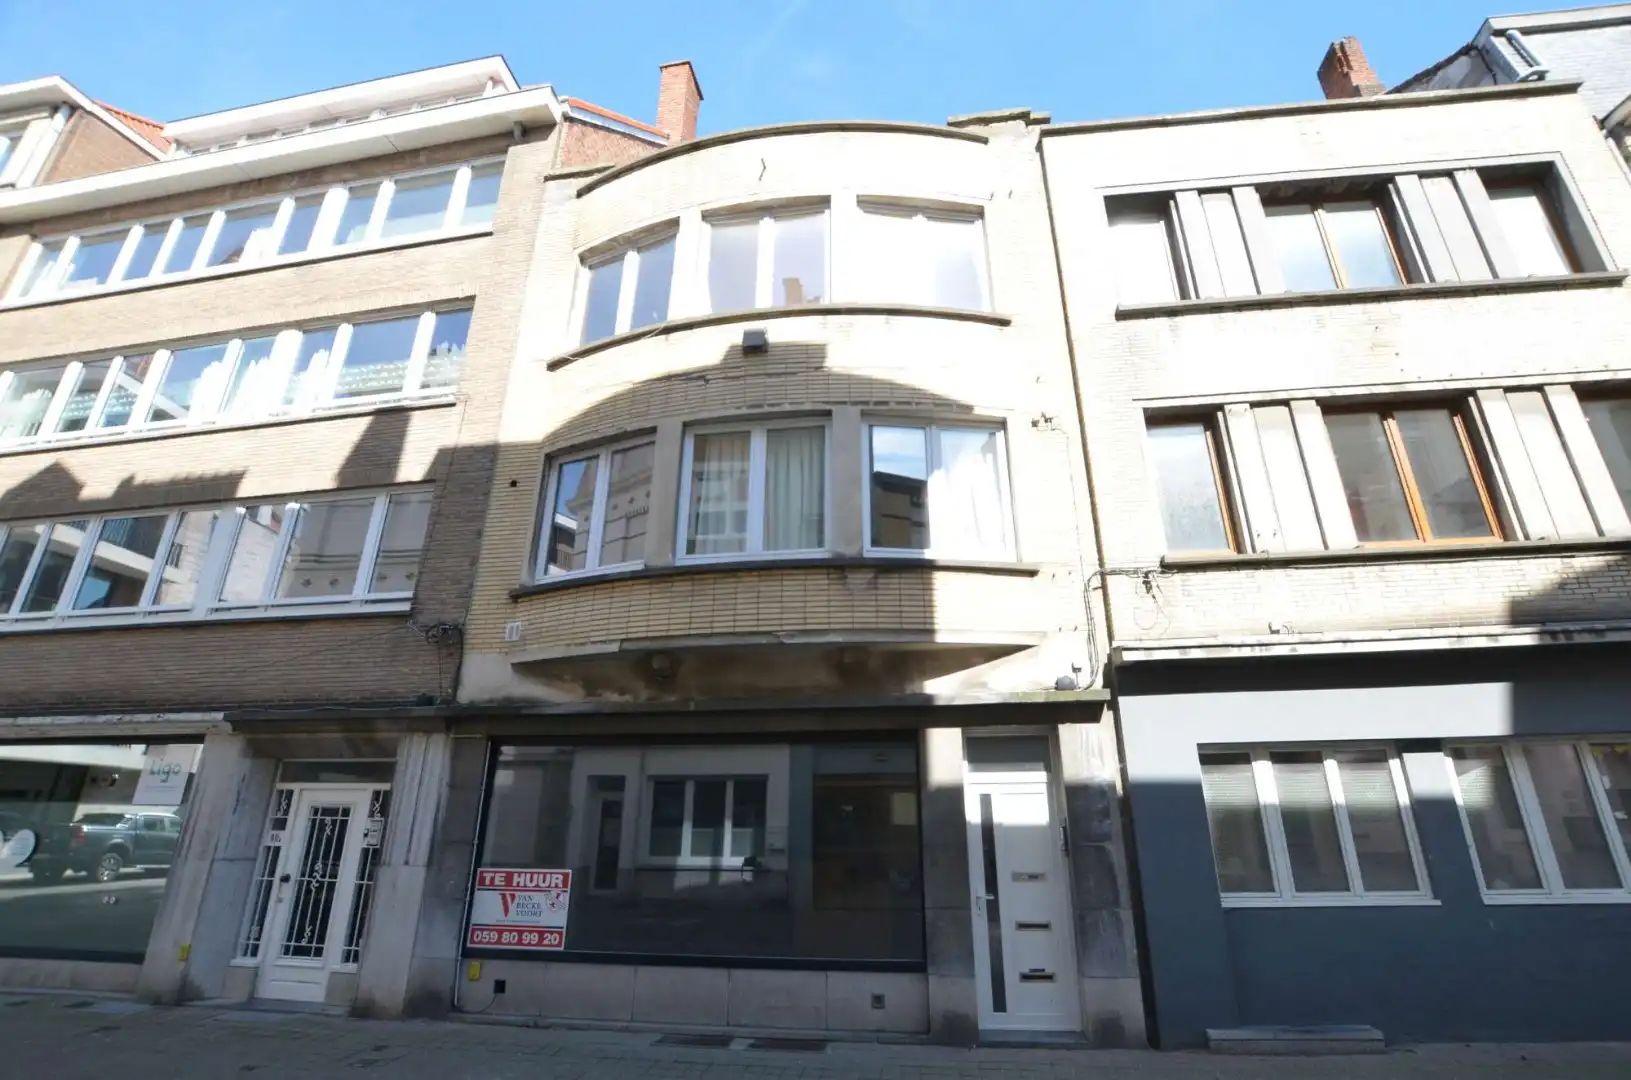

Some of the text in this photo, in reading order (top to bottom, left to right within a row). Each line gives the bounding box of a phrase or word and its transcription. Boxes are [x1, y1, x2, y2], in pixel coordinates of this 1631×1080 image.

[482, 872, 564, 888] TE HUUR
[473, 931, 560, 945] 059 80 99 20
